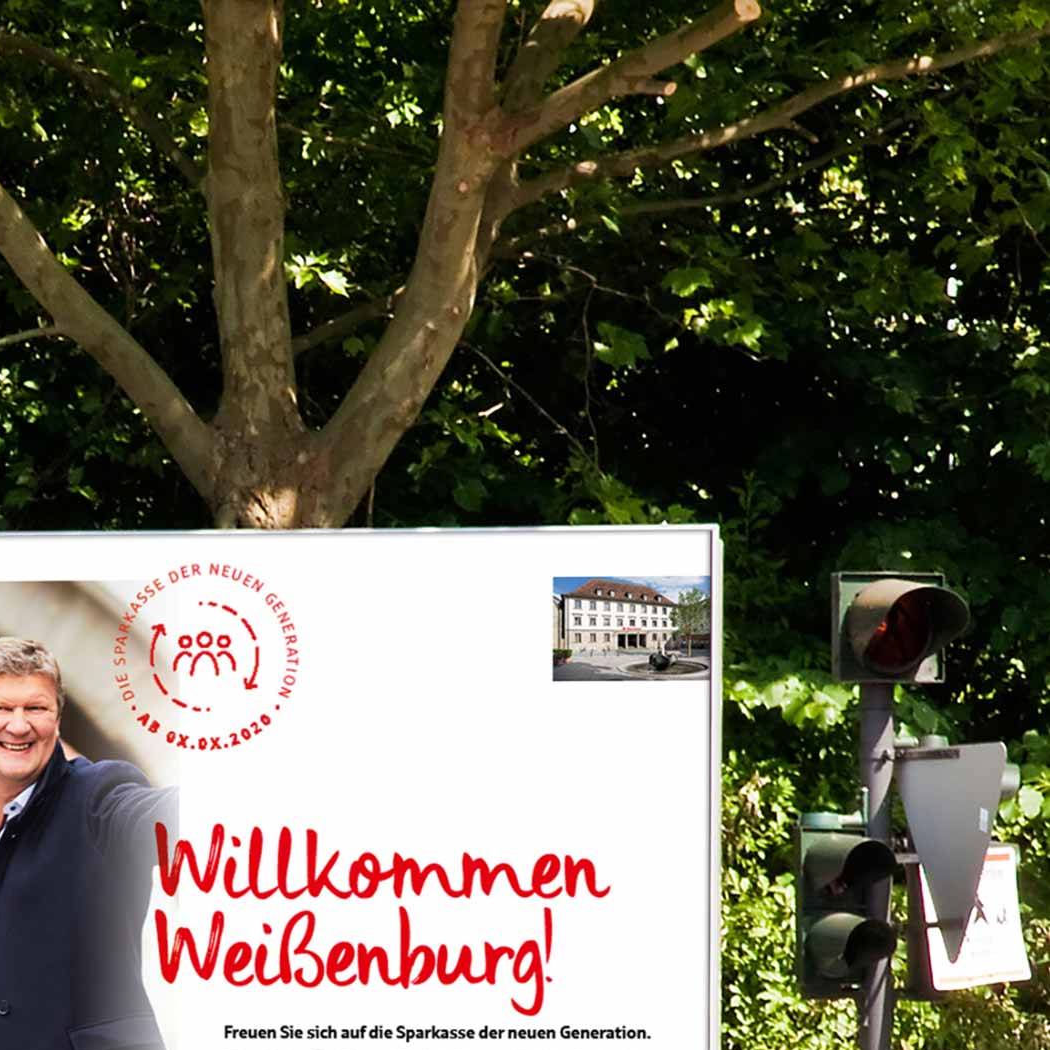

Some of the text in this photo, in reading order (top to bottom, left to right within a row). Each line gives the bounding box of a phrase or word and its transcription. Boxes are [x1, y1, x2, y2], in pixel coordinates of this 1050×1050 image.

[113, 563, 300, 702] DIE SPARKASSE DER NEUEN GENERATION
[137, 713, 161, 734] AB
[154, 820, 611, 900] Willkommen
[154, 905, 553, 1017] Weißenburg!
[224, 1024, 652, 1043] Freuen Sie sich auf die Sparkasse der neuen Generation.
